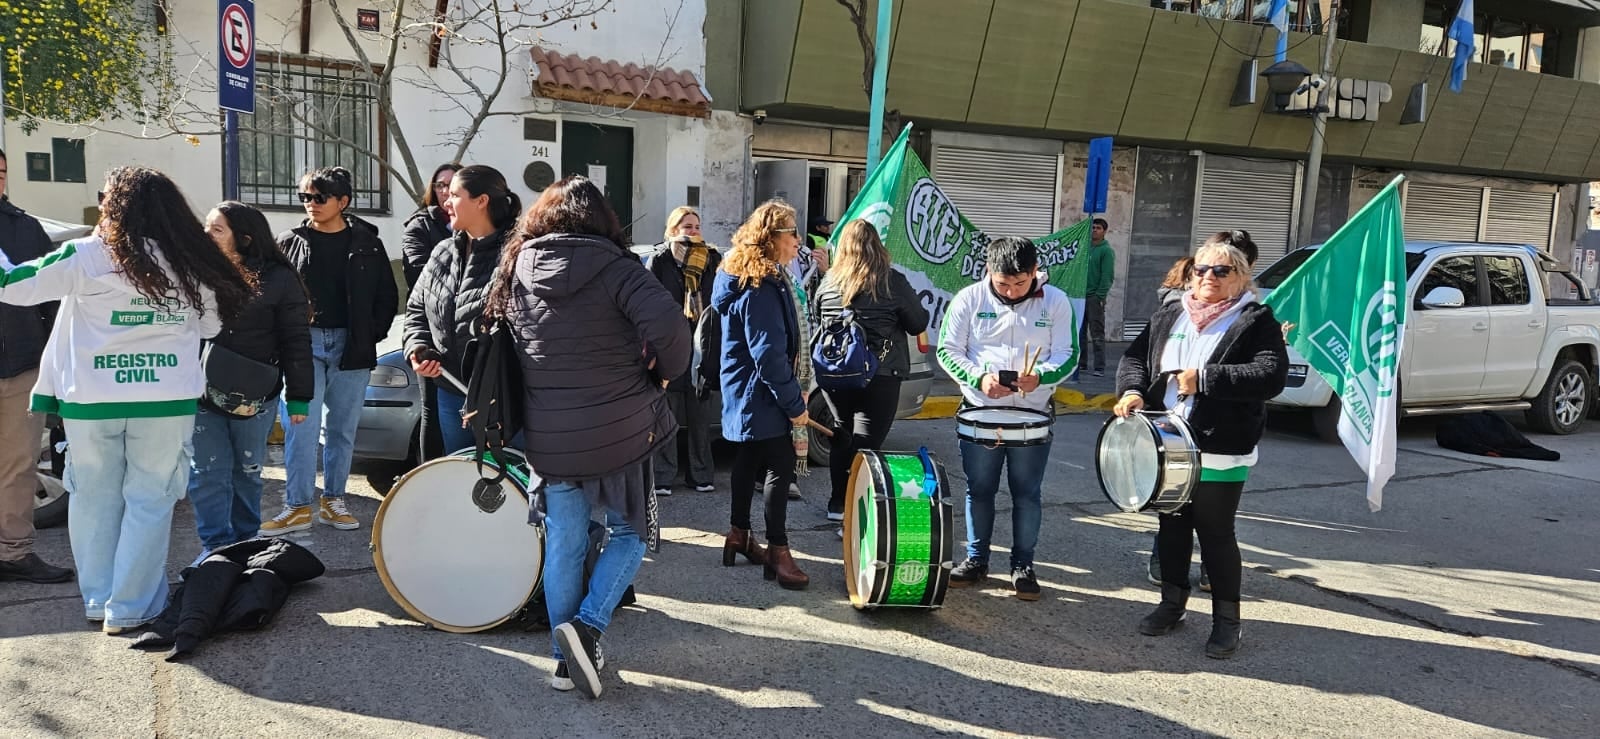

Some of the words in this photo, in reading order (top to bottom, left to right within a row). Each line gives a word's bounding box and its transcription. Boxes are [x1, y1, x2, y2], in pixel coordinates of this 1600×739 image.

[532, 146, 549, 157] 241
[118, 314, 149, 323] VERDE
[93, 353, 178, 369] REGISTRO
[115, 368, 160, 383] CIVIL
[1344, 384, 1372, 434] BLANCA
